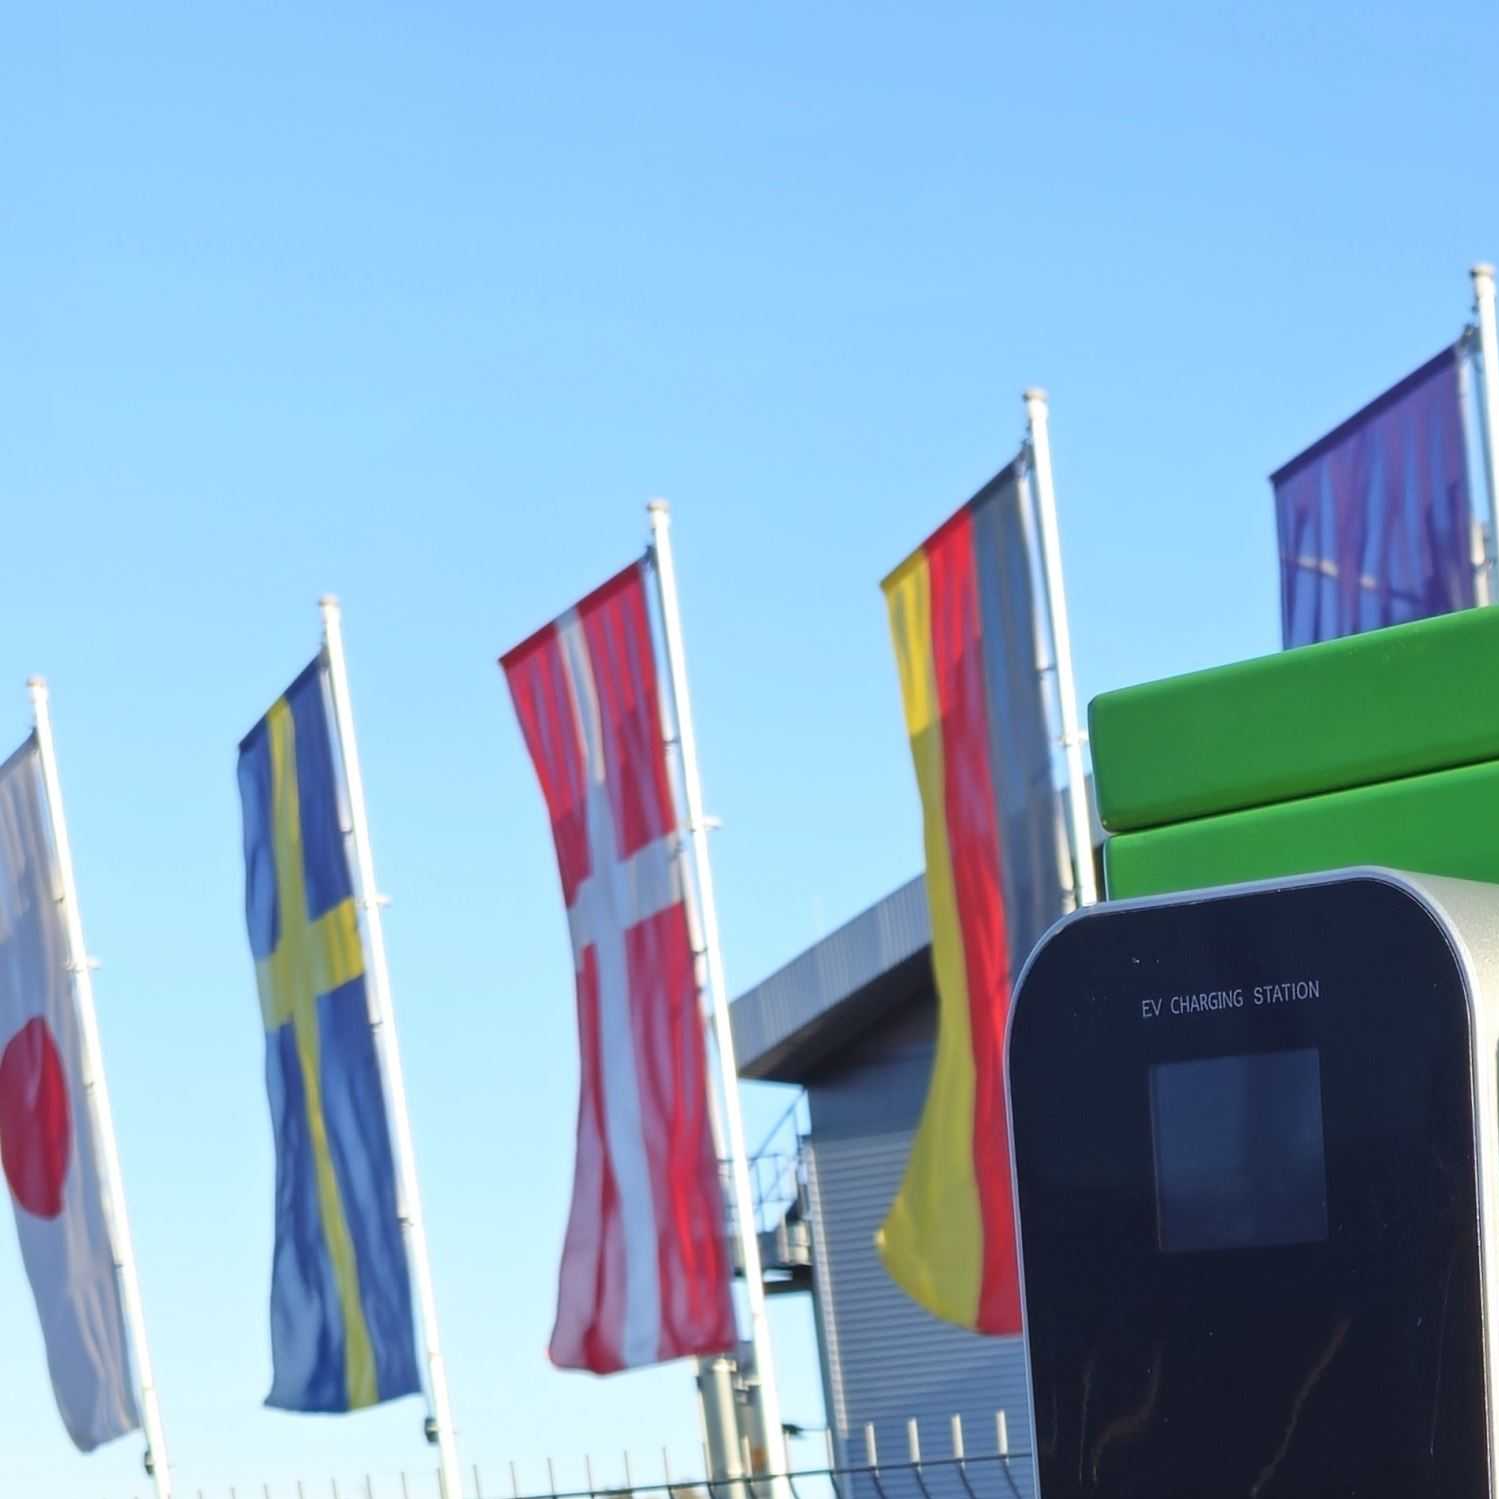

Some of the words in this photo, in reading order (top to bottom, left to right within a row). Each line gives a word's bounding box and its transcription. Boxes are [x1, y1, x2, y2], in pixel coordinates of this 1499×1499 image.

[1142, 999, 1162, 1018] EV
[1170, 989, 1244, 1014] CHARGING
[1254, 980, 1319, 1005] STATION
